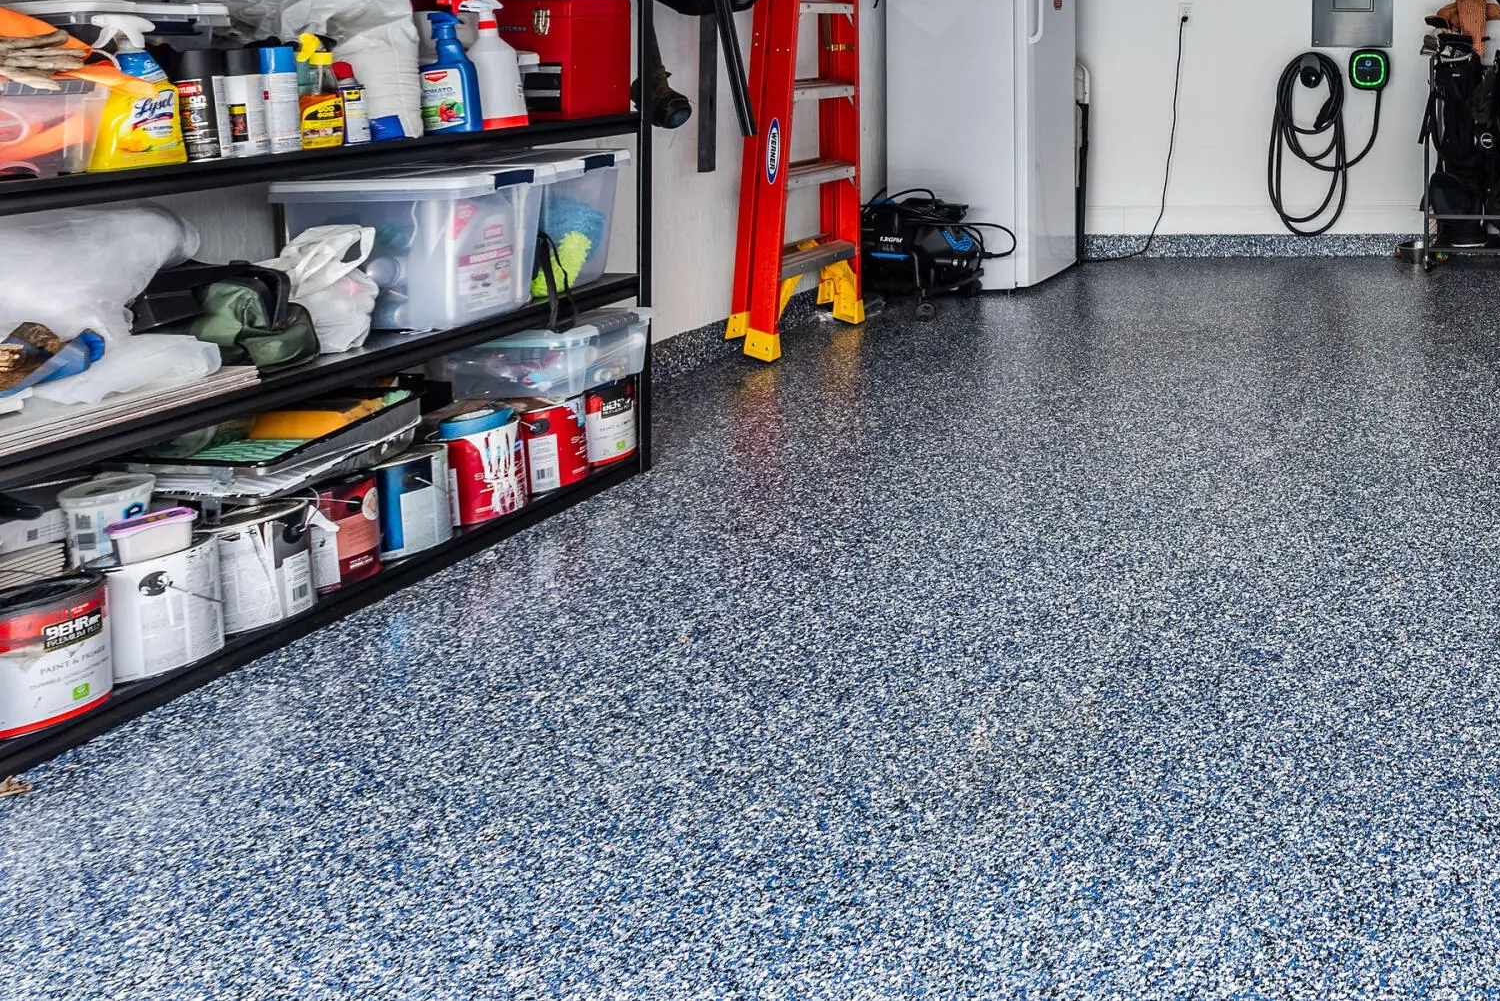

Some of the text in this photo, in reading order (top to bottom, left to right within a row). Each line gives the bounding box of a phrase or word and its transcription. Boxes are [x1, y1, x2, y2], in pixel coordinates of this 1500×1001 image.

[134, 93, 174, 118] Lysol
[769, 132, 778, 170] WERNER
[45, 615, 89, 639] BEHR
[46, 630, 86, 648] PREMIUM
[39, 660, 70, 676] PAINT
